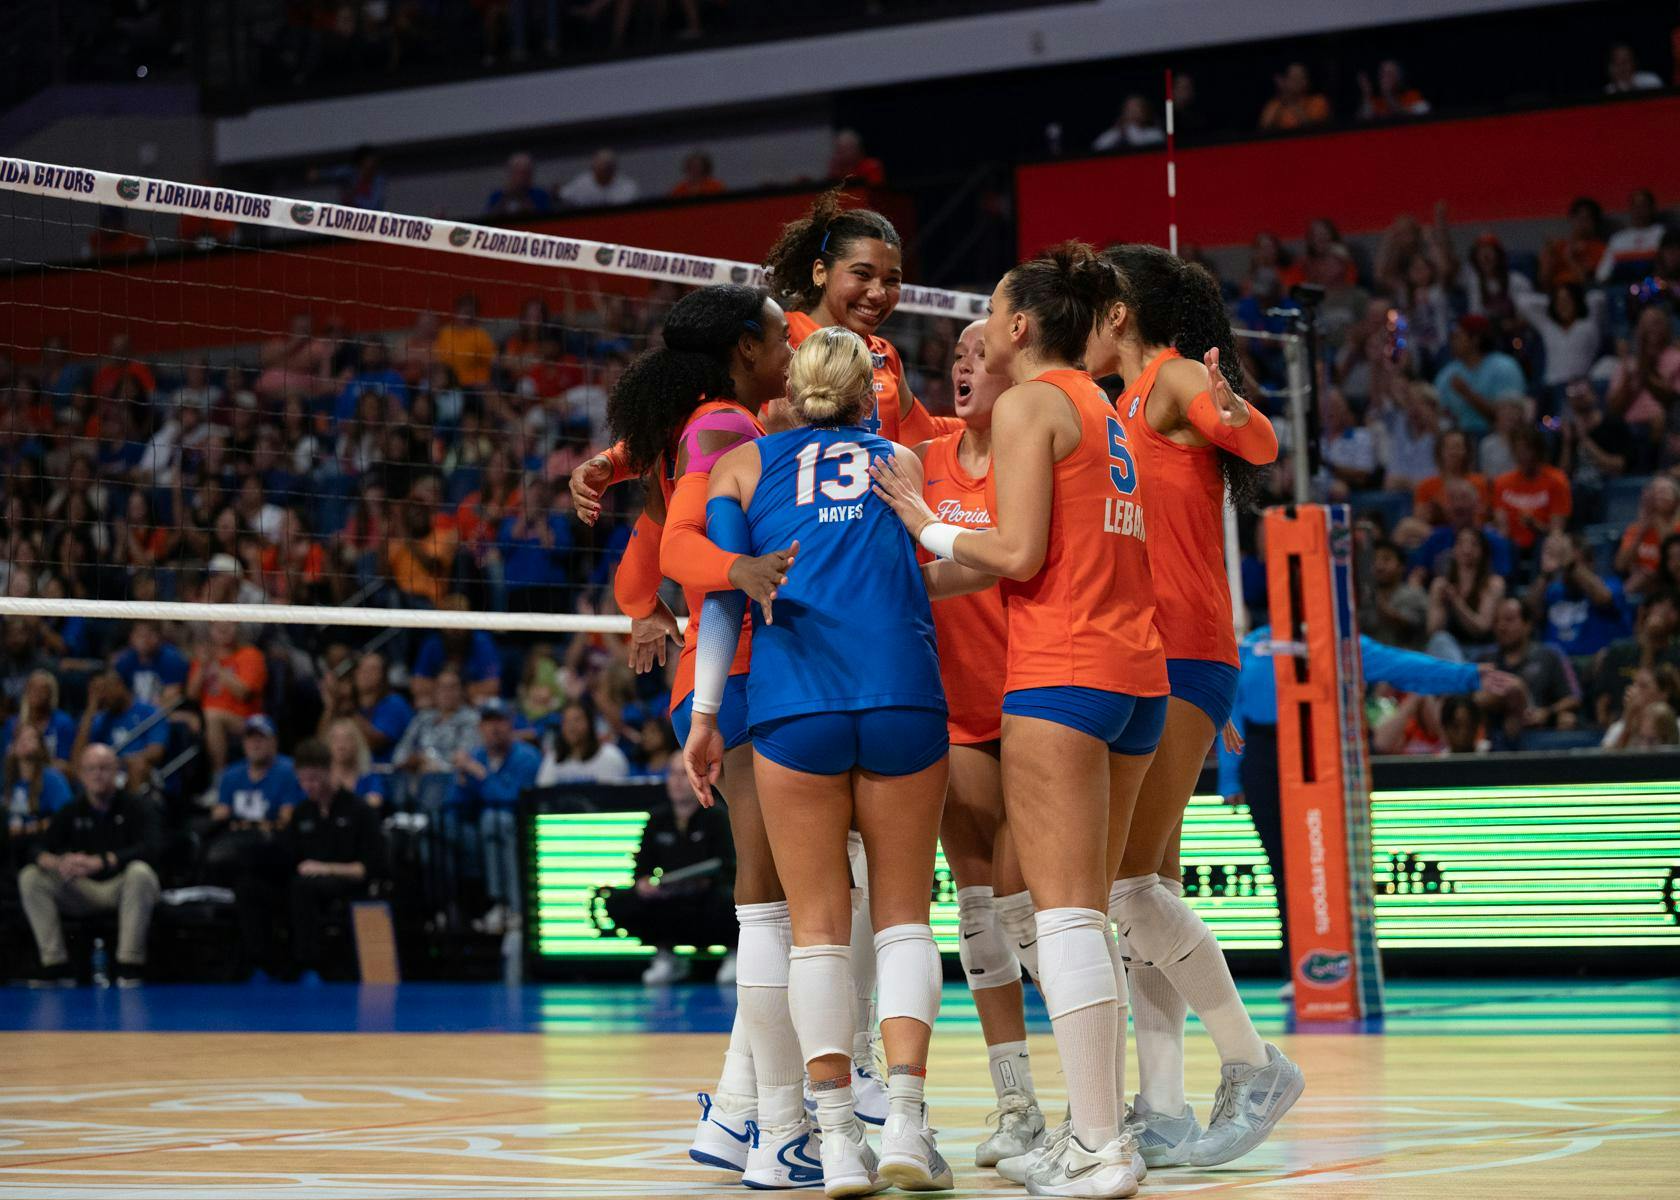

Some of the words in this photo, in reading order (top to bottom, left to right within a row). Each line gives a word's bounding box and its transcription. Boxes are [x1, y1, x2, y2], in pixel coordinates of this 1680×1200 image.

[33, 165, 96, 193] GATORS
[145, 182, 212, 210] FLORIDA
[213, 191, 272, 219] GATORS
[317, 202, 378, 234] FLORIDA
[379, 216, 433, 241] GATORS
[473, 230, 528, 256] FLORIDA
[530, 238, 581, 261] GATORS
[617, 249, 668, 274] FLORIDA
[669, 257, 716, 279] GATORS
[1106, 415, 1137, 495] 5
[795, 440, 871, 506] 13
[818, 503, 864, 523] HAYES
